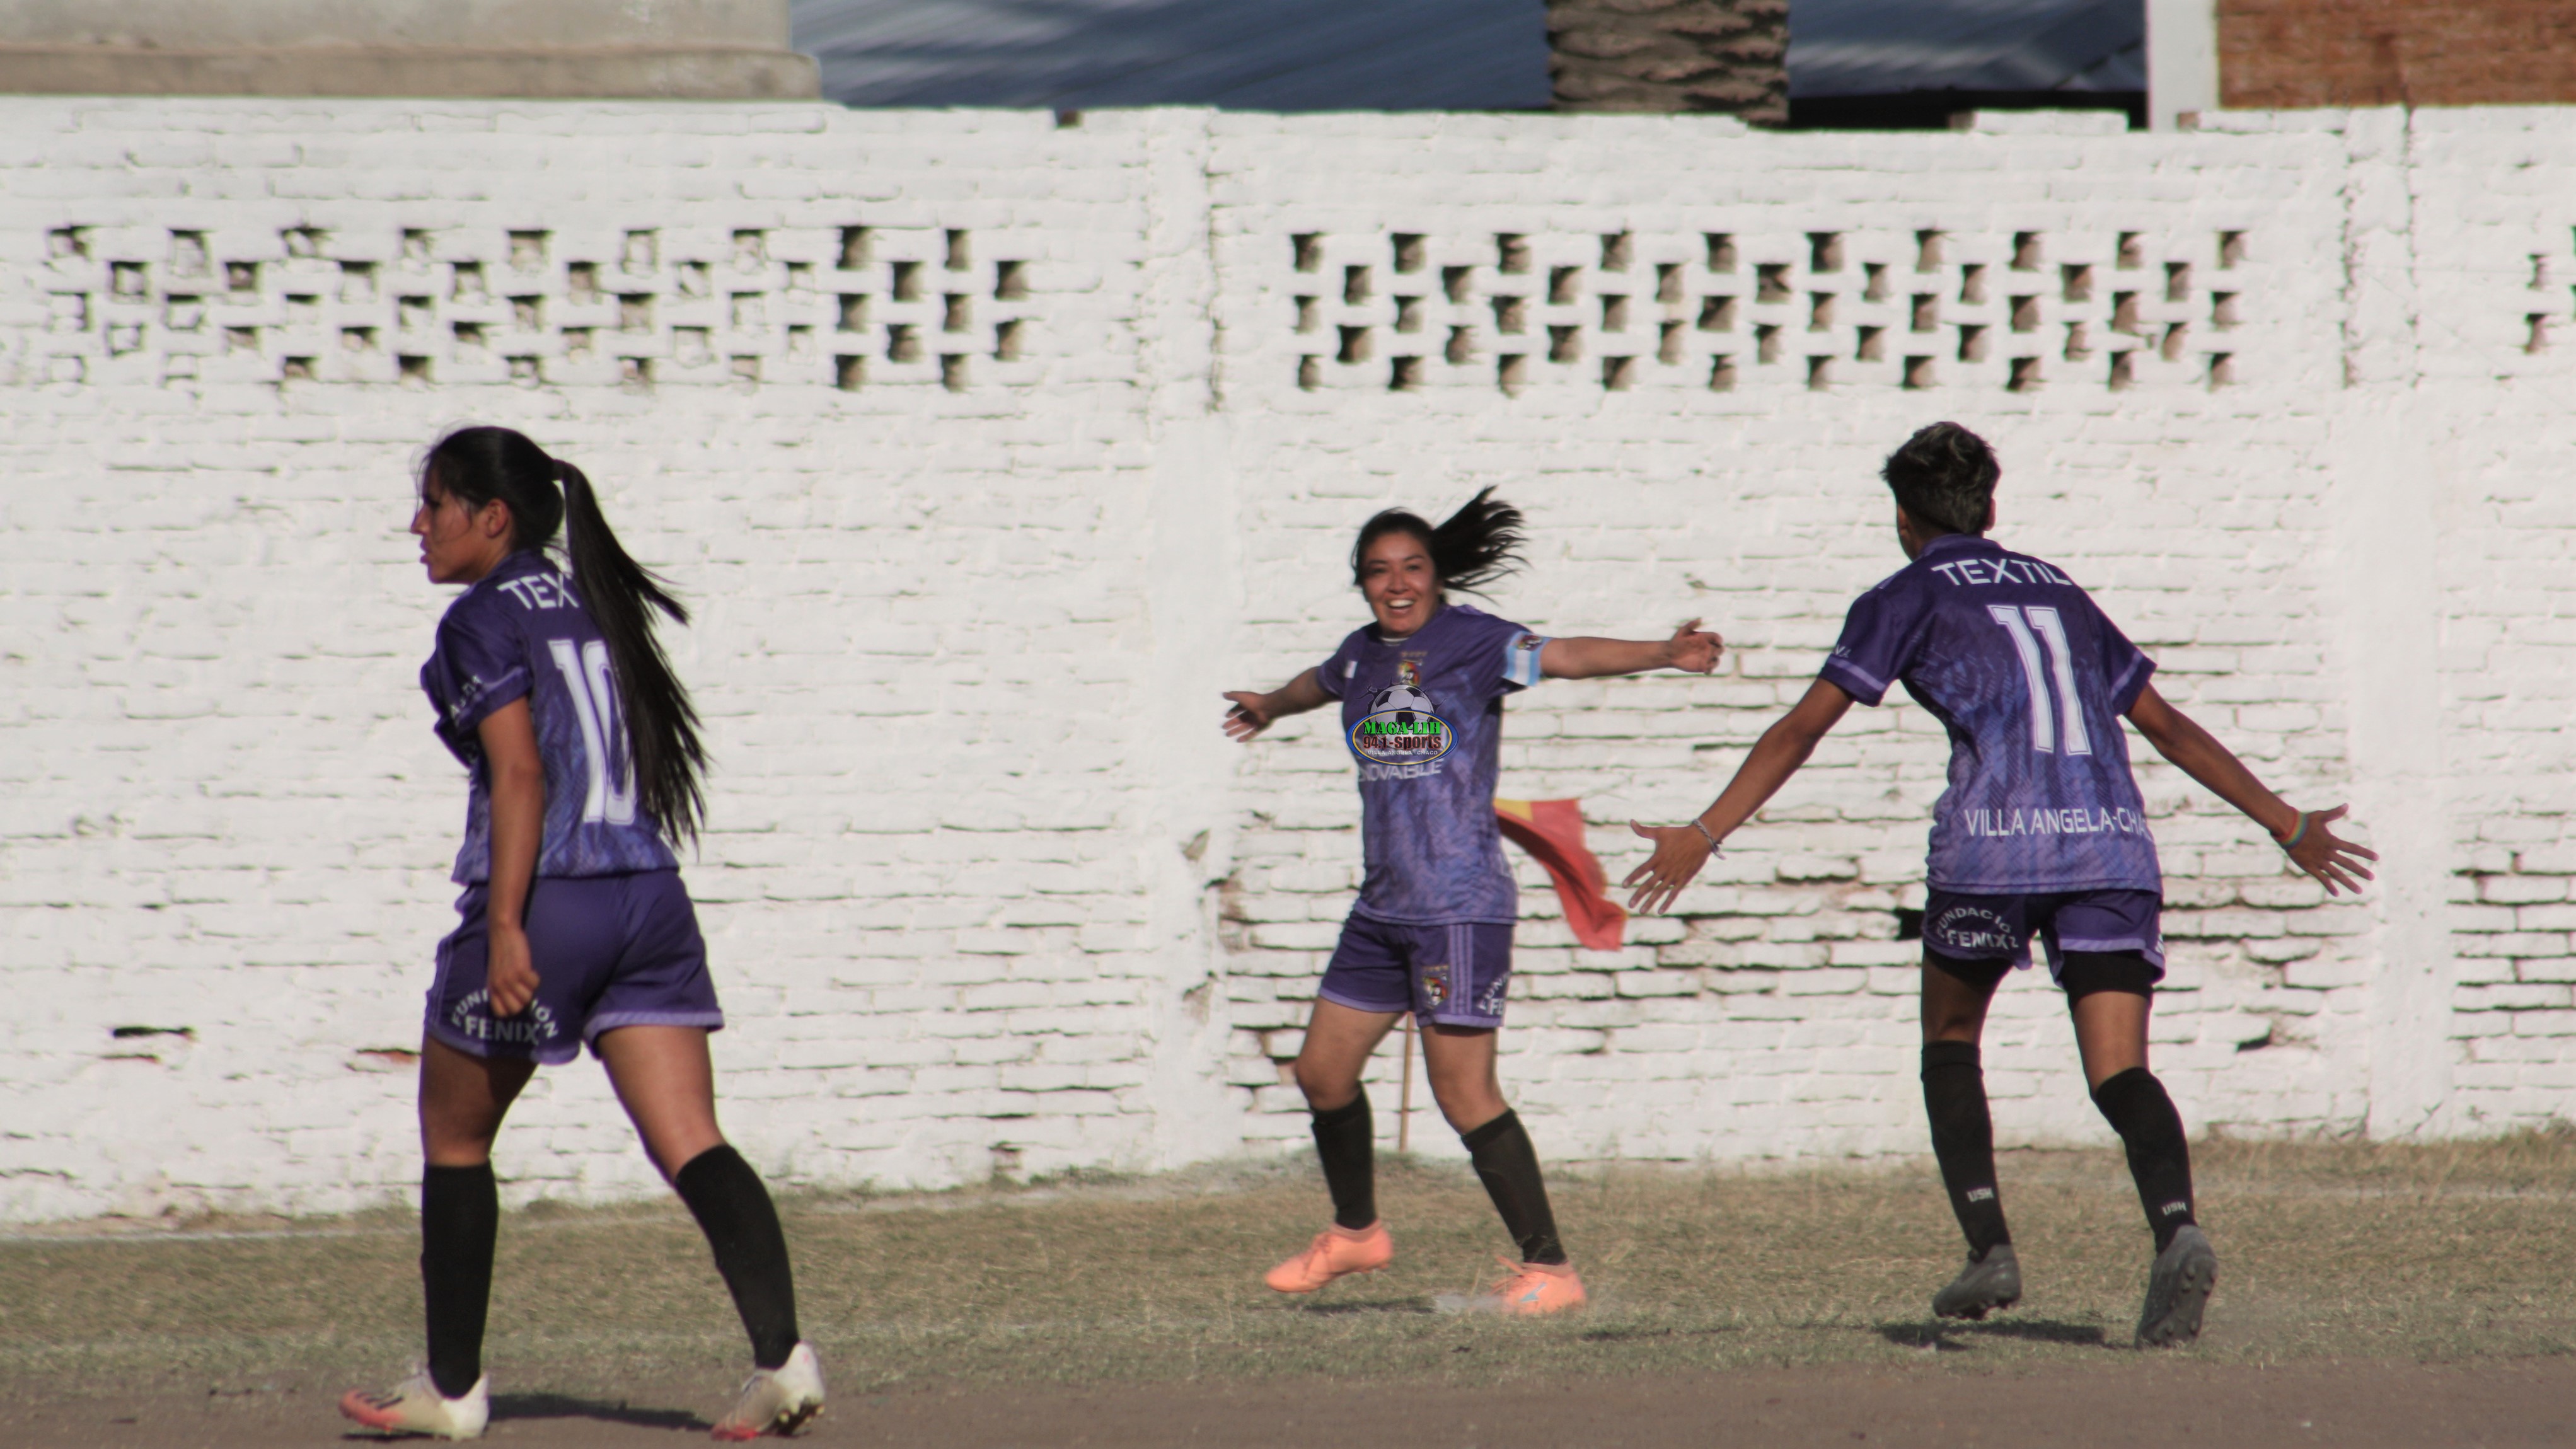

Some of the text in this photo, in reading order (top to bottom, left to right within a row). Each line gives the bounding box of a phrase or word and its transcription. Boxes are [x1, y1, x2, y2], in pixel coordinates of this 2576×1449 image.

[1931, 558, 2073, 586] TEXTIL
[1985, 604, 2093, 756] 11
[546, 639, 636, 826] 10
[1965, 808, 2026, 837] VILLA
[1946, 929, 2009, 950] FENIX
[464, 1014, 541, 1045] FENIX
